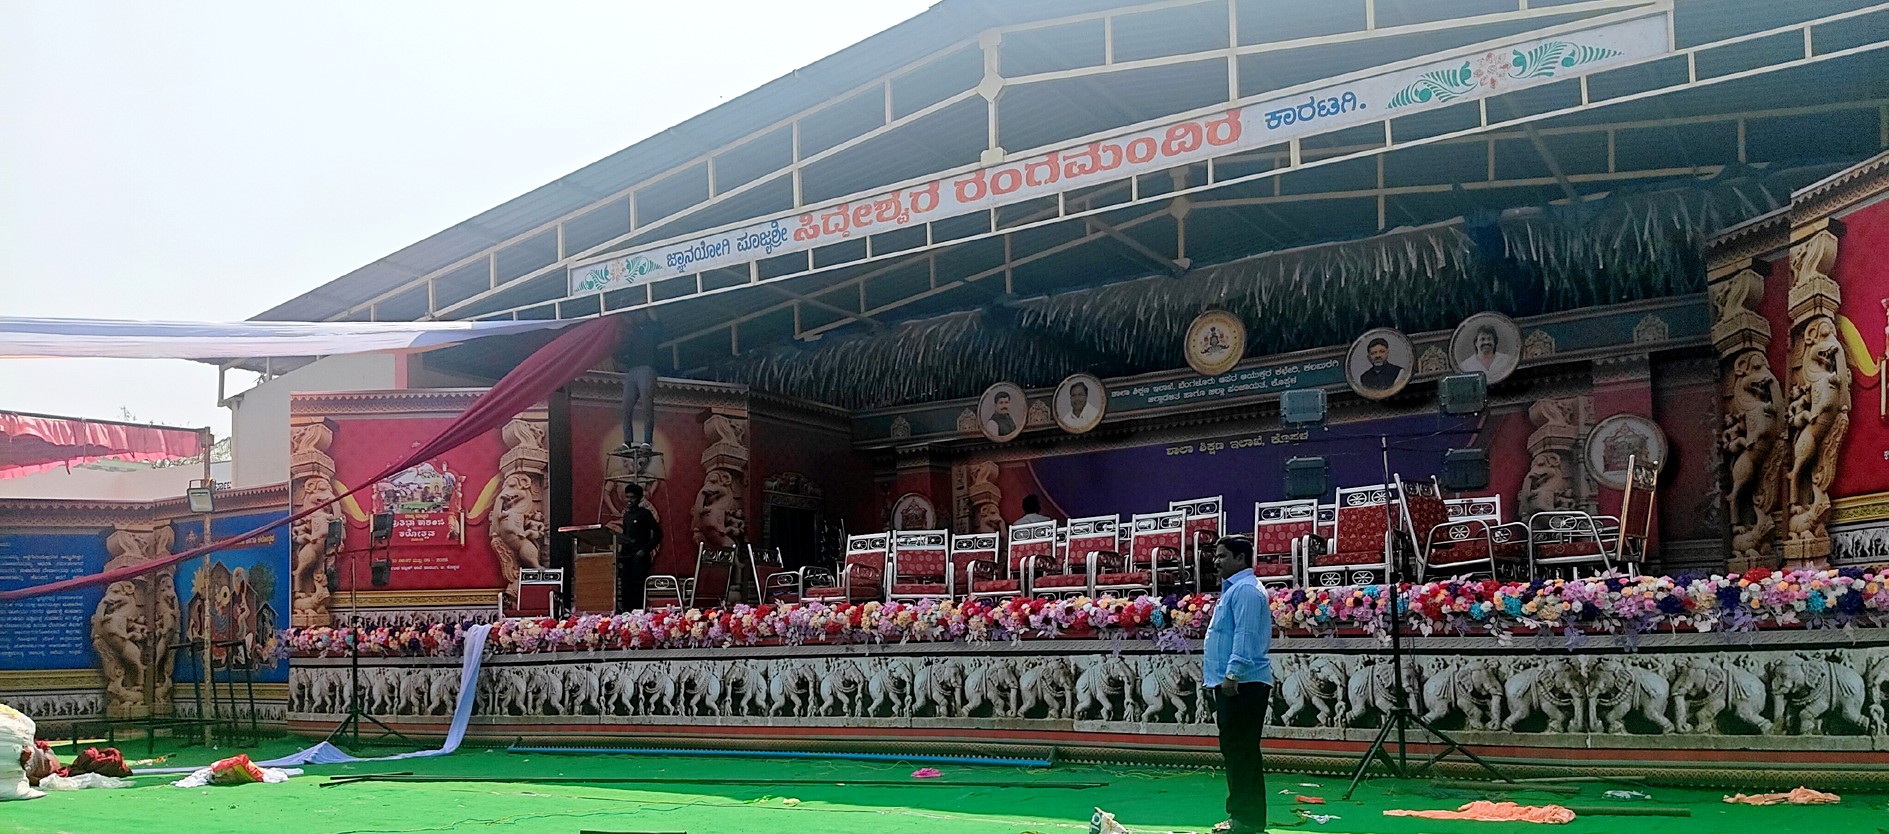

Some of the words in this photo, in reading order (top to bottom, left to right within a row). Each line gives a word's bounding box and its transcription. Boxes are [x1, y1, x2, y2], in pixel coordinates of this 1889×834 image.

[666, 238, 731, 273] ಜ್ಞಾನಯೋಗಿ
[737, 221, 788, 255] ಪೂಜ್ಯಶ್ರೀ
[954, 109, 1243, 204] ರಂಗಮಂದಿರ
[1264, 91, 1367, 131] ಕಾರಟಗಿ.
[1166, 445, 1194, 456] ಶಾಲಾ
[1198, 441, 1225, 455] ಶಿಕ್ಷಣ
